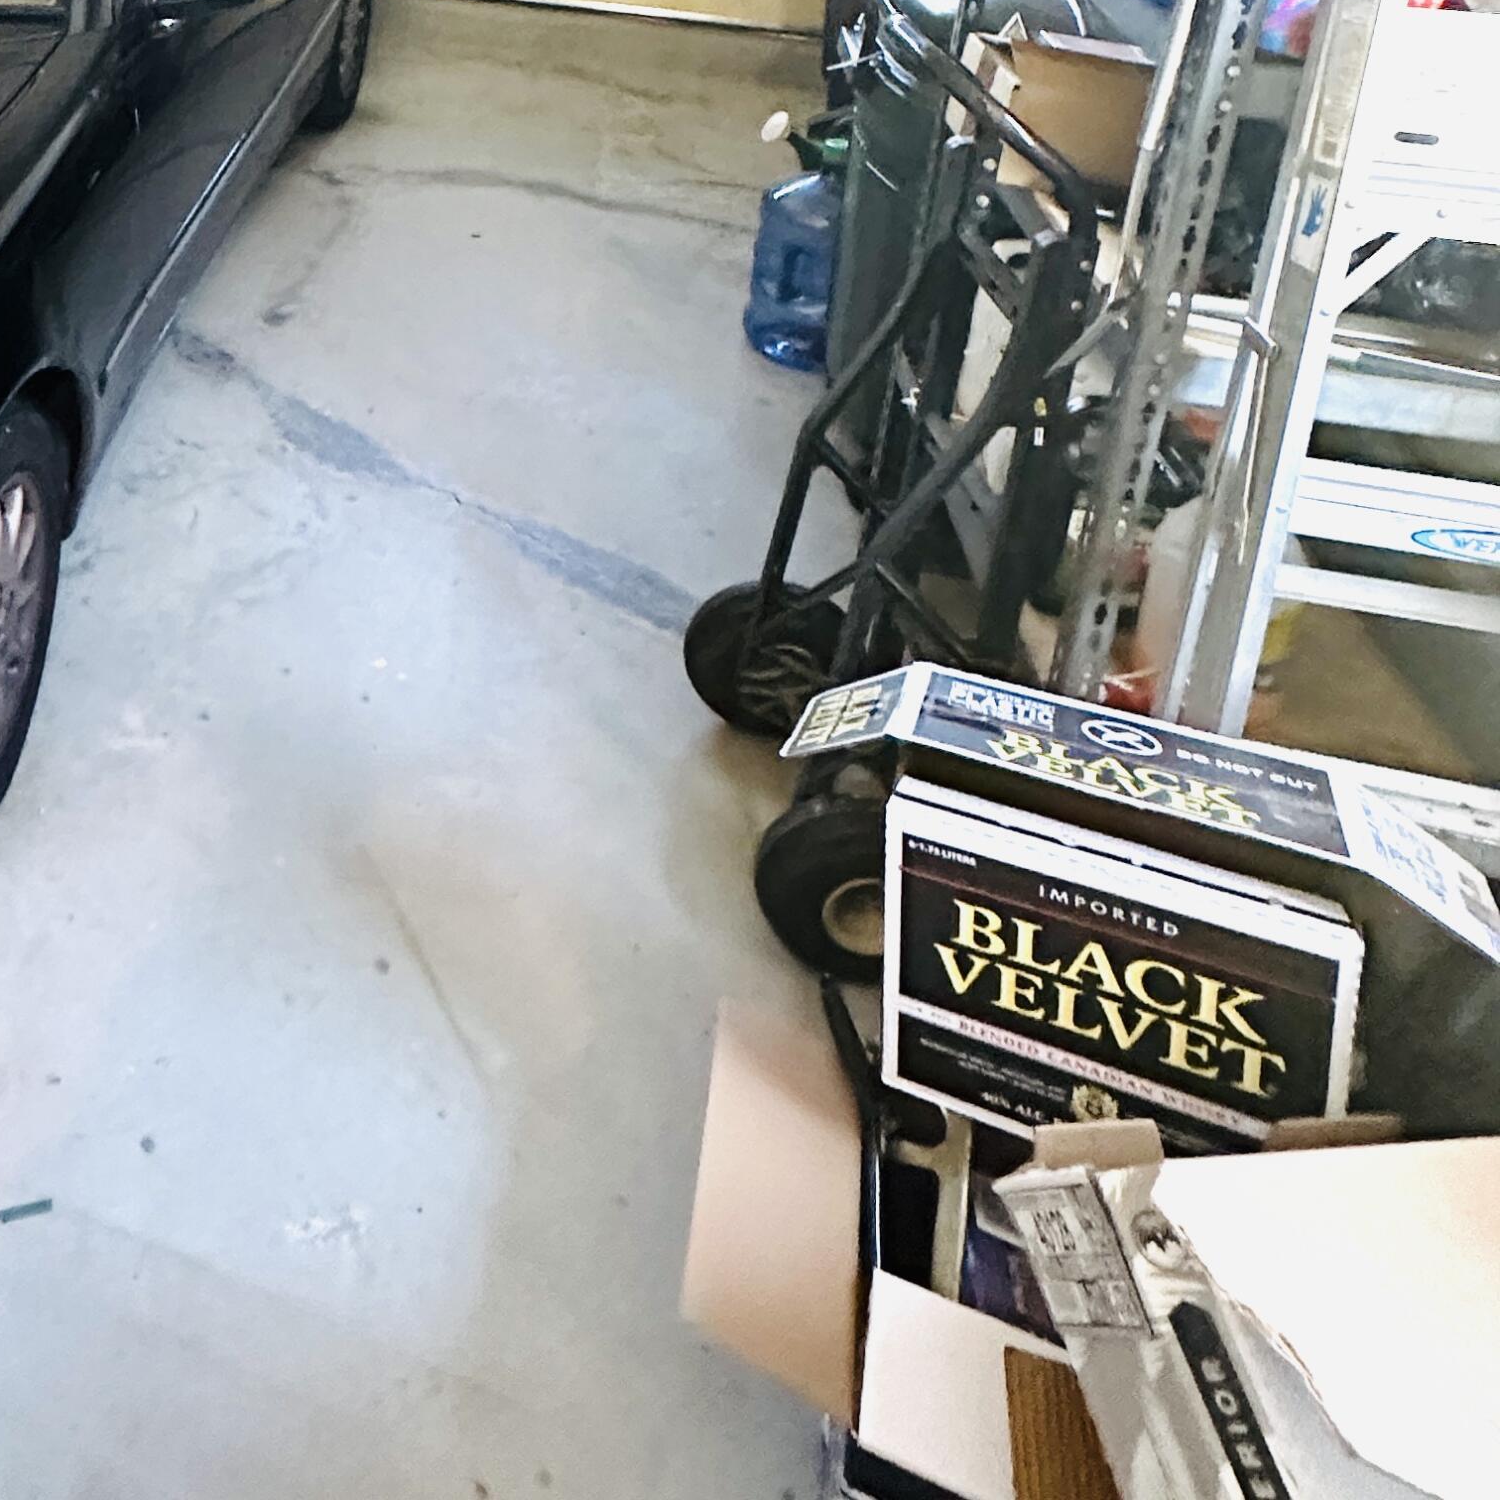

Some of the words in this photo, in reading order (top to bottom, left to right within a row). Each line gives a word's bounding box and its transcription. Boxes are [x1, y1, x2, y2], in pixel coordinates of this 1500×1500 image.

[985, 739, 1263, 829] VELVET
[1002, 729, 1243, 809] BLACK
[1214, 757, 1264, 780] NOT
[1038, 883, 1180, 938] IMPORTED
[952, 898, 1268, 1046] BLACK
[933, 942, 1287, 1098] VELVET
[958, 1020, 1040, 1055] BLENDED
